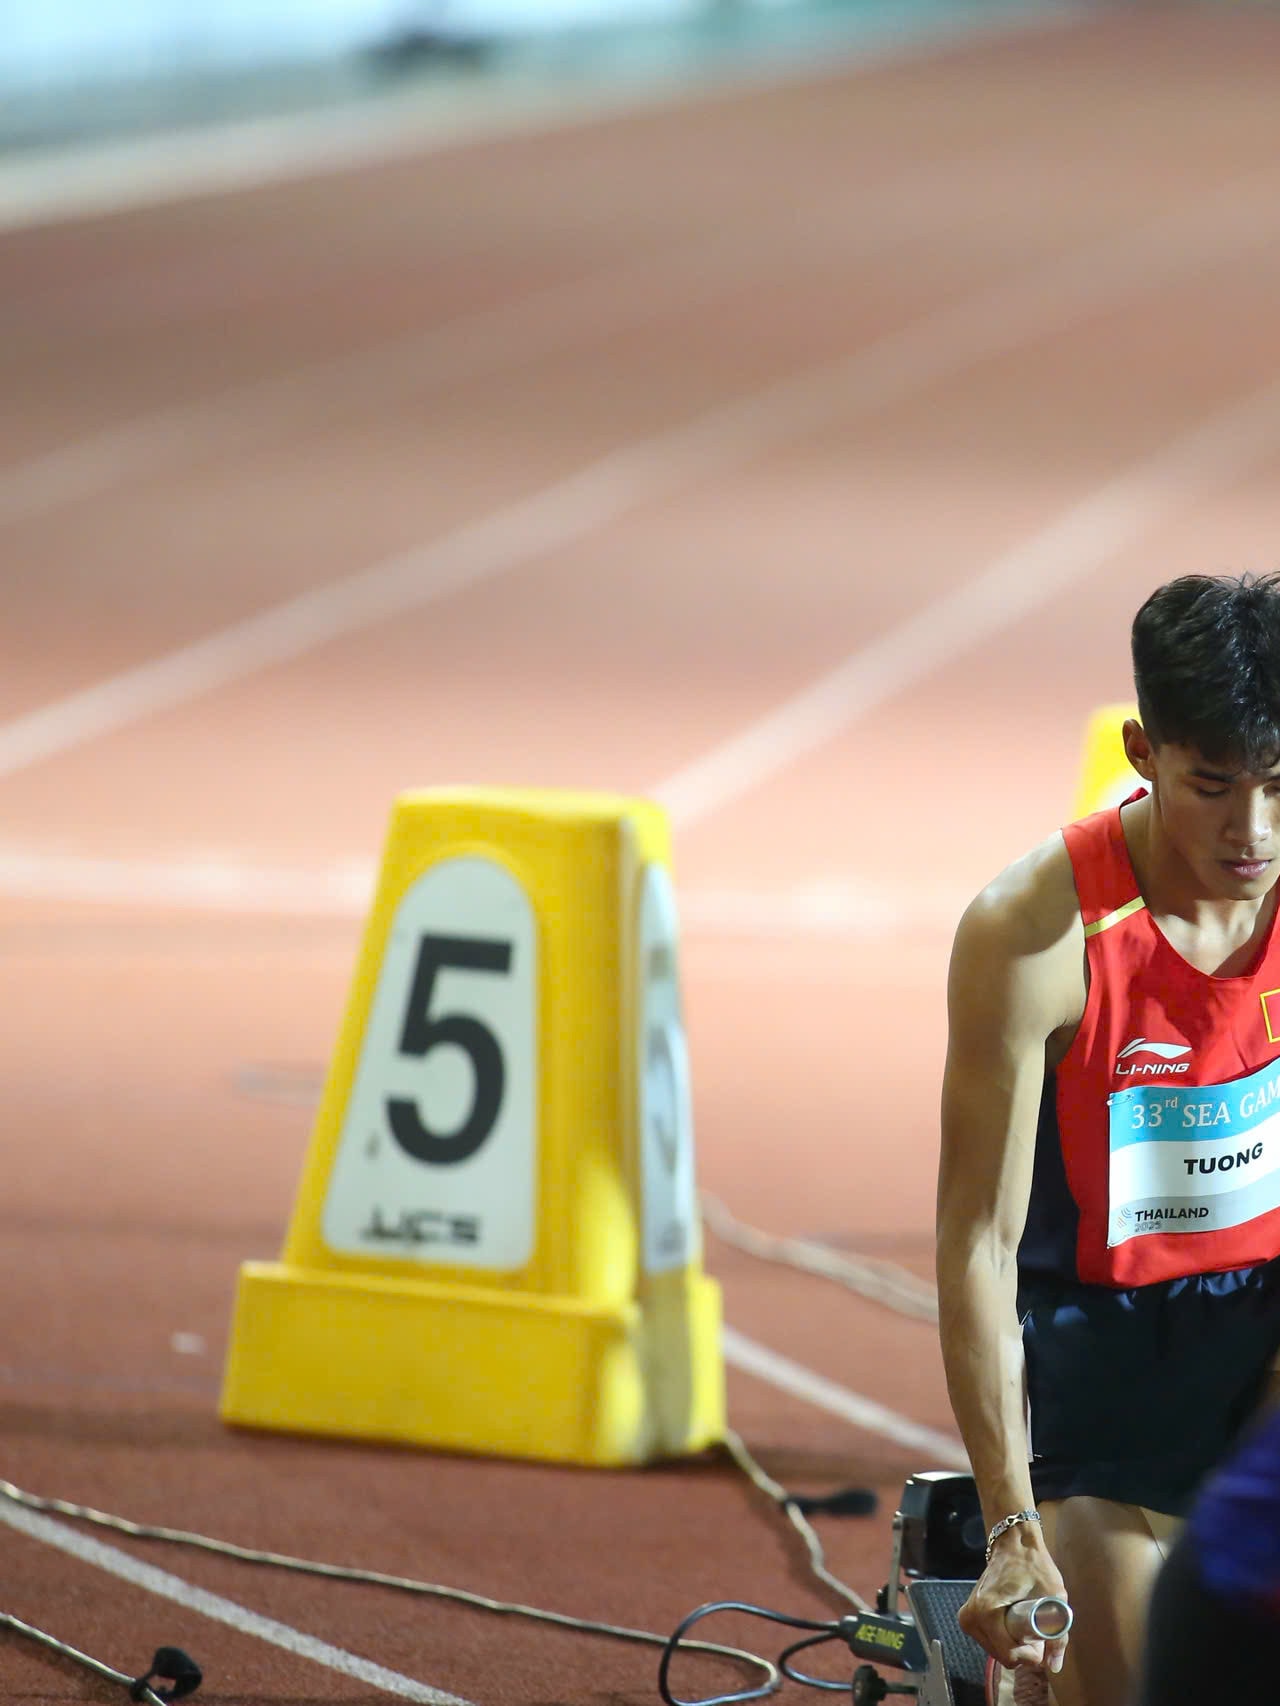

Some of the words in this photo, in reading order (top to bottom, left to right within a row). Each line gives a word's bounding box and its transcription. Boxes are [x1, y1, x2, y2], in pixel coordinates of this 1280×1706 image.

[386, 929, 514, 1166] 5
[1116, 1062, 1190, 1075] LI-NING
[1131, 1096, 1178, 1129] 33rd
[1182, 1103, 1232, 1128] SEA
[1184, 1142, 1264, 1175] TUONG
[1135, 1207, 1209, 1222] THAILAND
